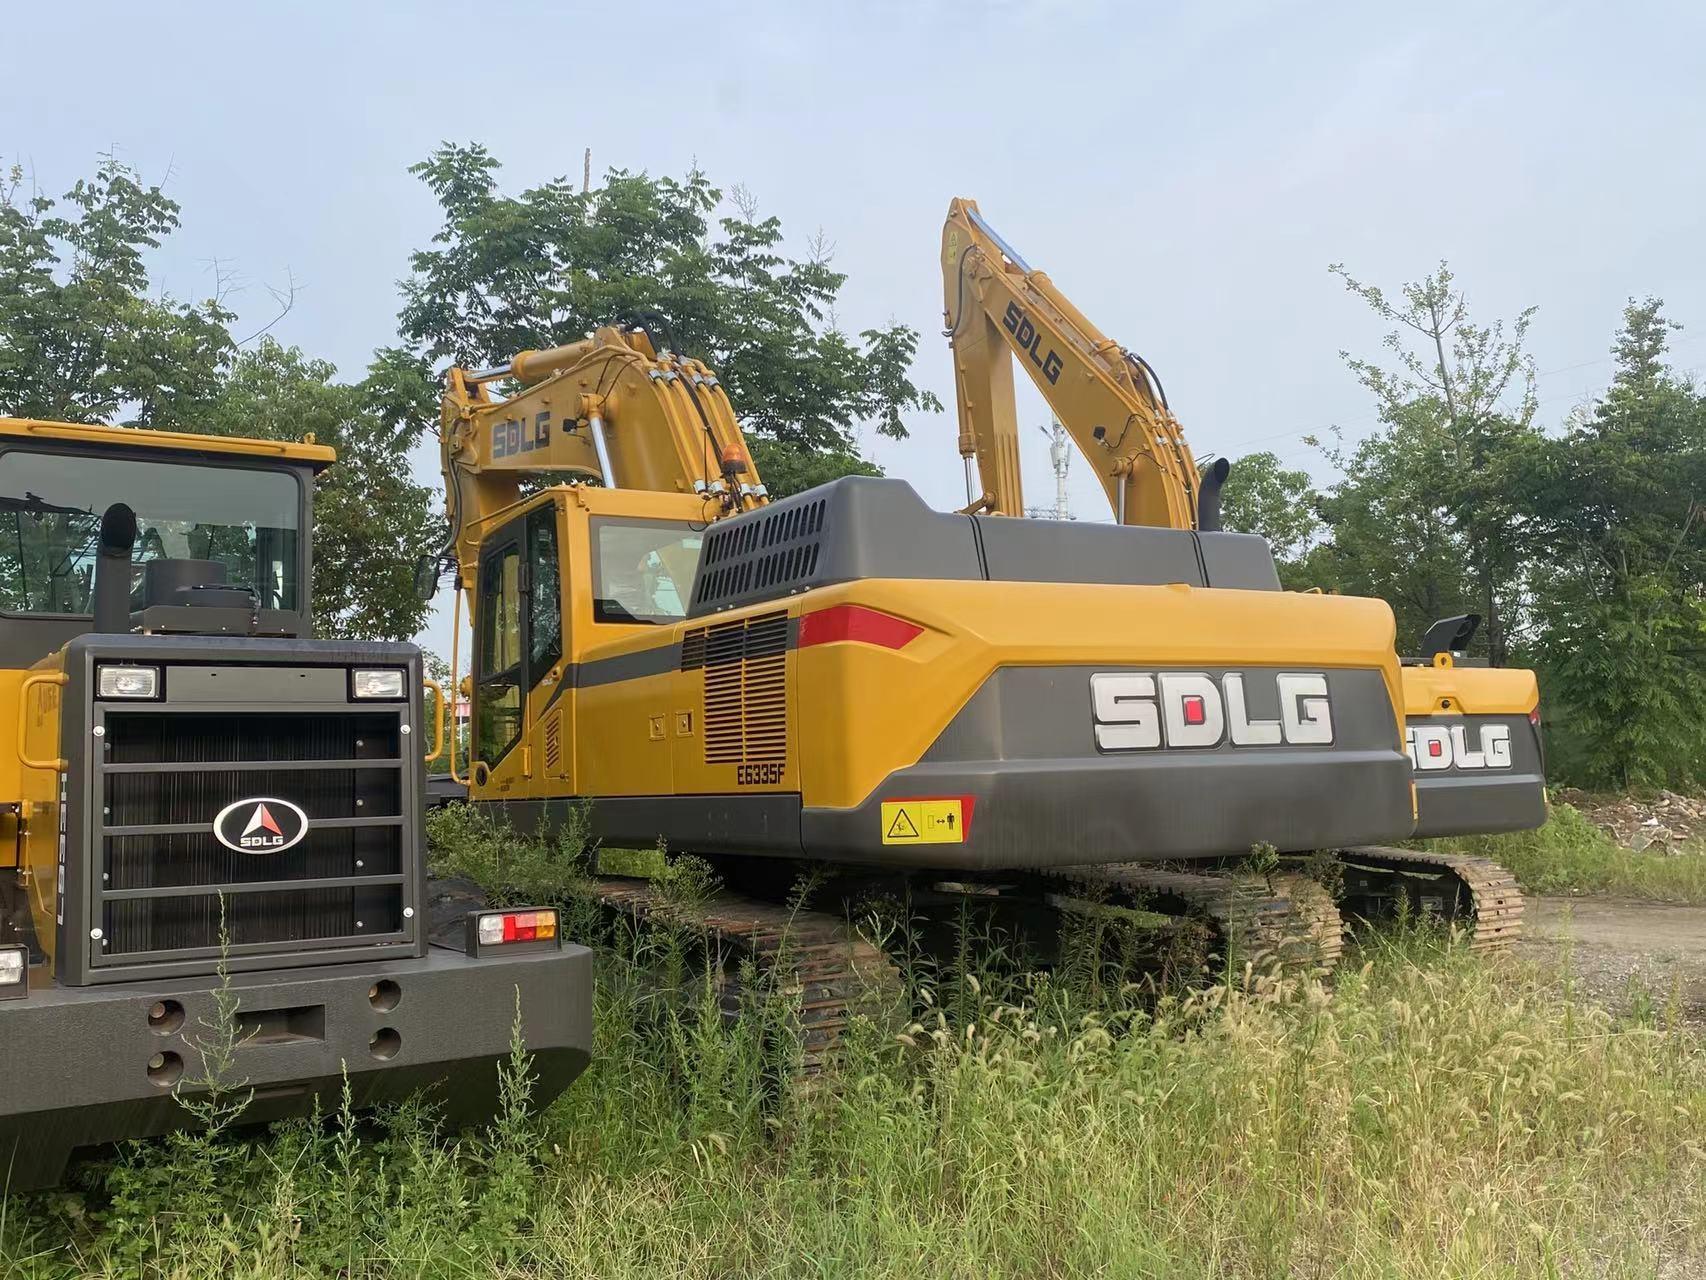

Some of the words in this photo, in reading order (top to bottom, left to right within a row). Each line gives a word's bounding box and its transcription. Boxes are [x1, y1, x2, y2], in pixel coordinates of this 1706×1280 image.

[1003, 300, 1063, 385] SDLG
[493, 411, 550, 459] SDLG
[1090, 672, 1333, 751] SDLG
[1405, 725, 1511, 770] DLG
[737, 763, 785, 785] E6335F
[240, 836, 283, 847] SDLG
